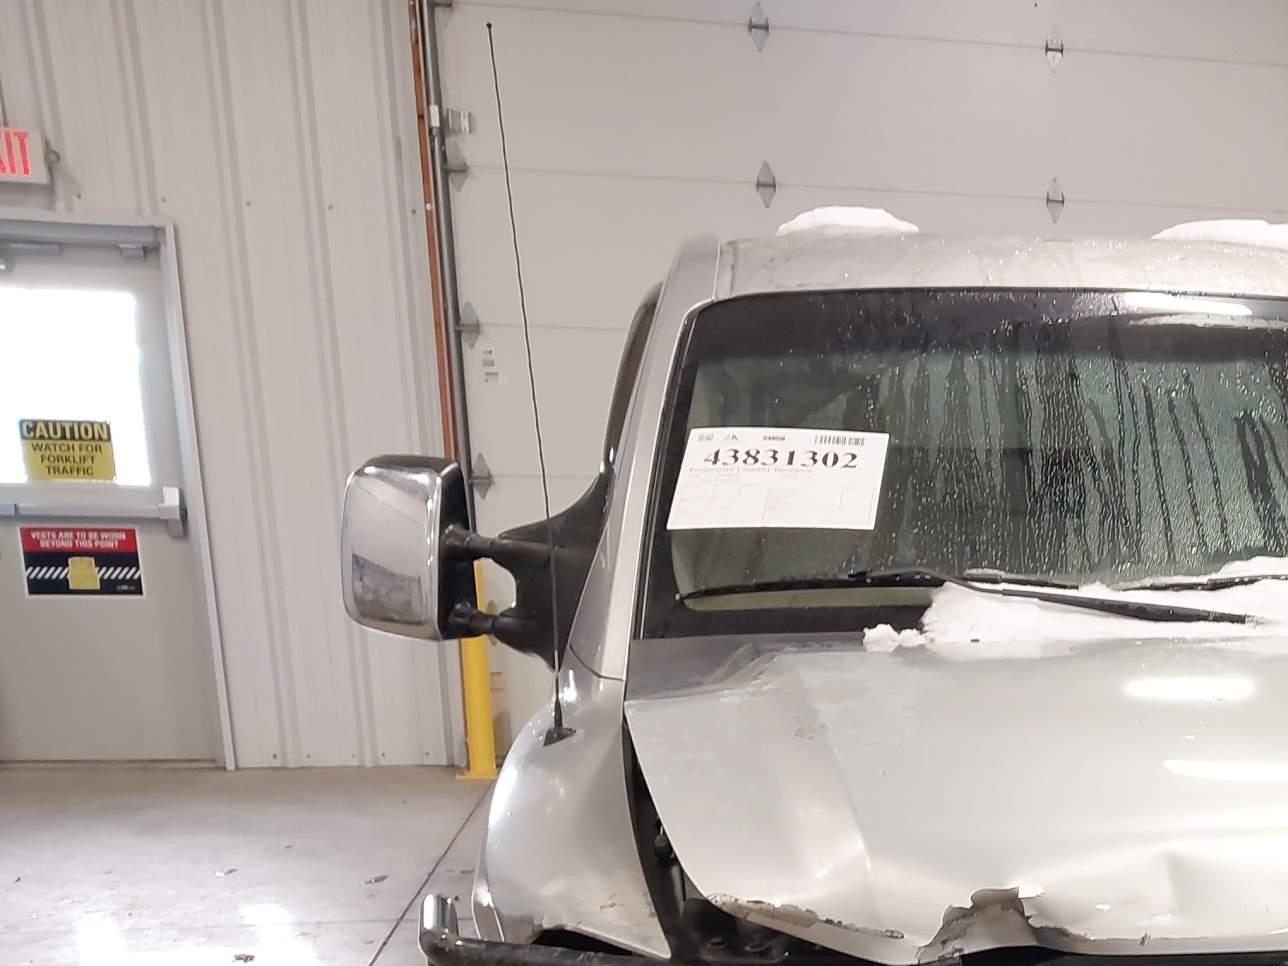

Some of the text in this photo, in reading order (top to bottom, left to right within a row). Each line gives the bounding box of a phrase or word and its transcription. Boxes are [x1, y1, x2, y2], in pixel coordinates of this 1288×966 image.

[0, 130, 30, 176] IT
[22, 421, 108, 440] CAUTION
[31, 443, 102, 453] WATCH FOR
[40, 455, 95, 464] FORKLIFT
[704, 448, 858, 469] 43831302
[46, 466, 94, 476] TRAFFIC
[31, 531, 56, 540] VESTS
[77, 532, 86, 540] TO
[88, 532, 98, 540] BE
[76, 540, 92, 549] THIS
[95, 540, 119, 549] POINT
